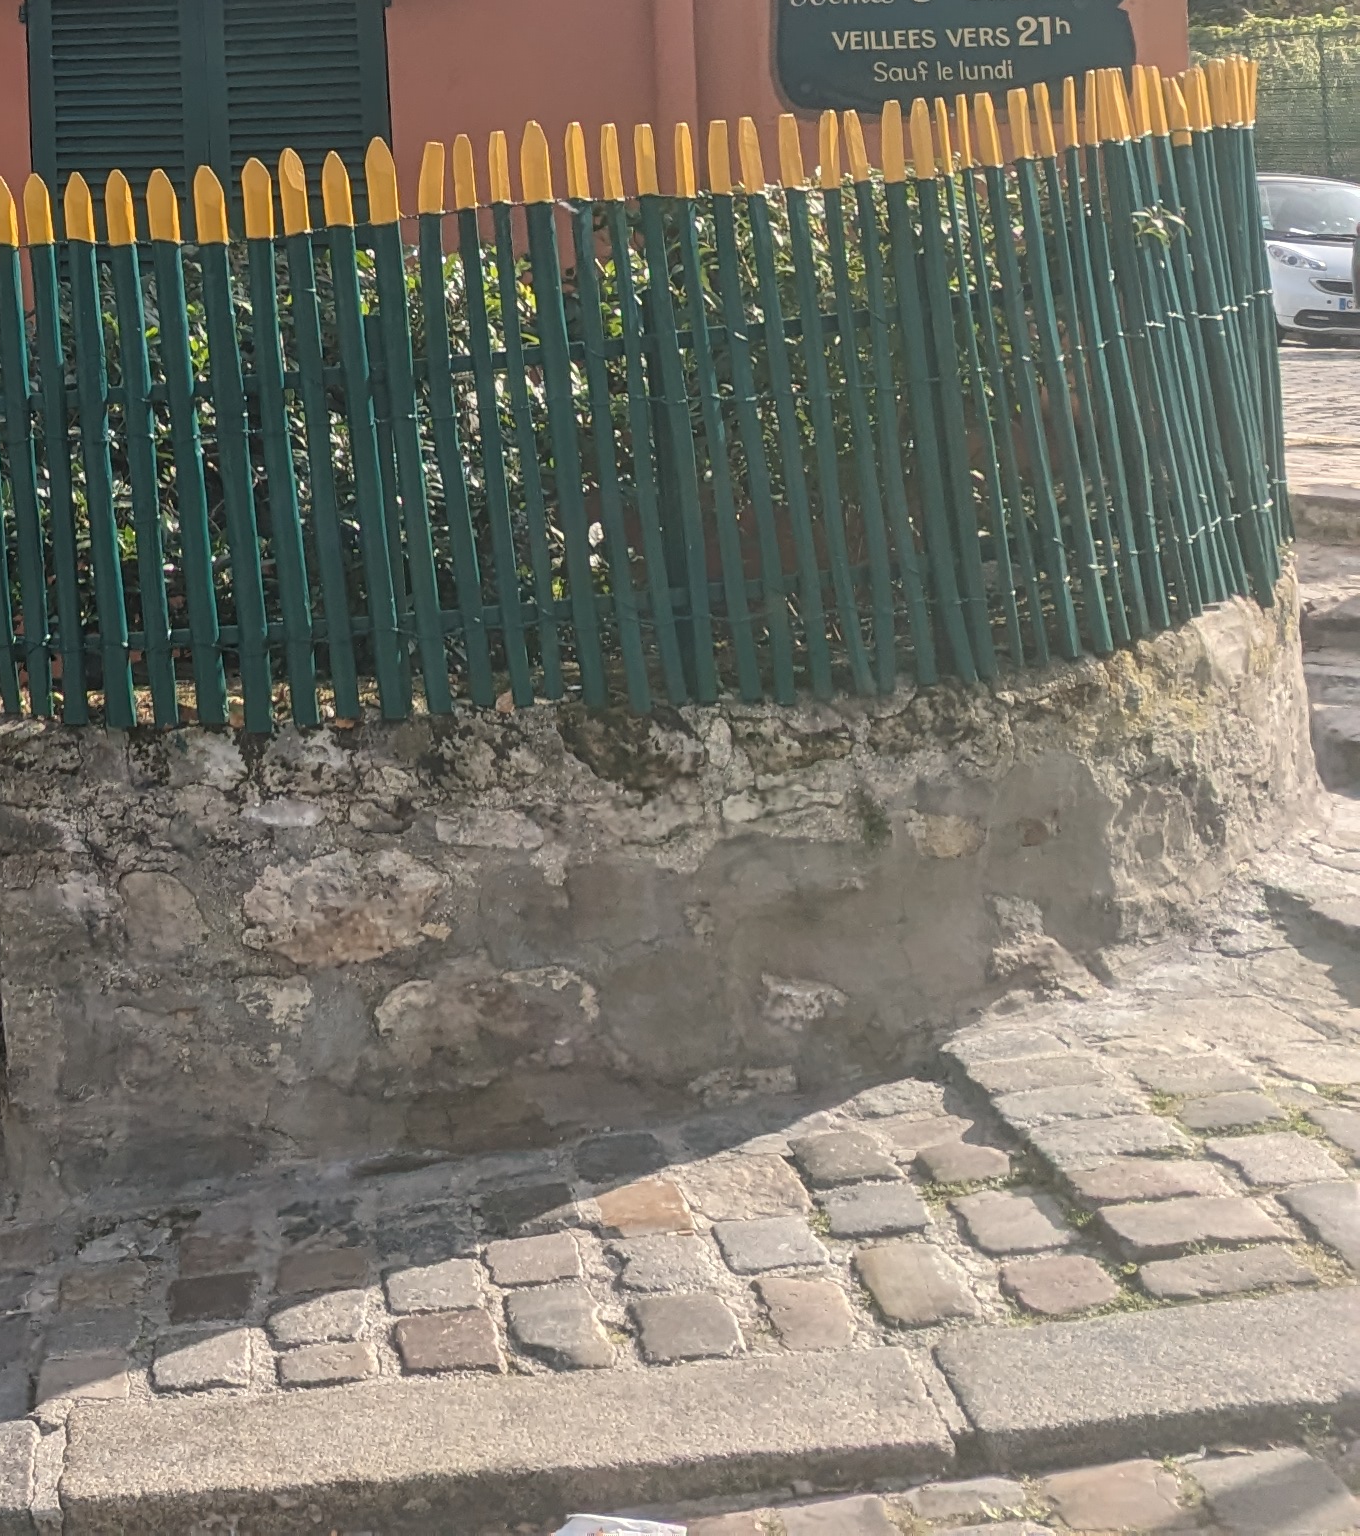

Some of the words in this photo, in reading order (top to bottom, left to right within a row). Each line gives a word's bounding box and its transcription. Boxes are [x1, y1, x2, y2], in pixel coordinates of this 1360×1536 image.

[831, 29, 937, 51] VEILLEES
[945, 27, 1011, 49] VERS
[1016, 16, 1072, 47] 21h
[874, 61, 929, 82] Sauf
[937, 61, 954, 81] le
[959, 59, 1014, 81] lundi
